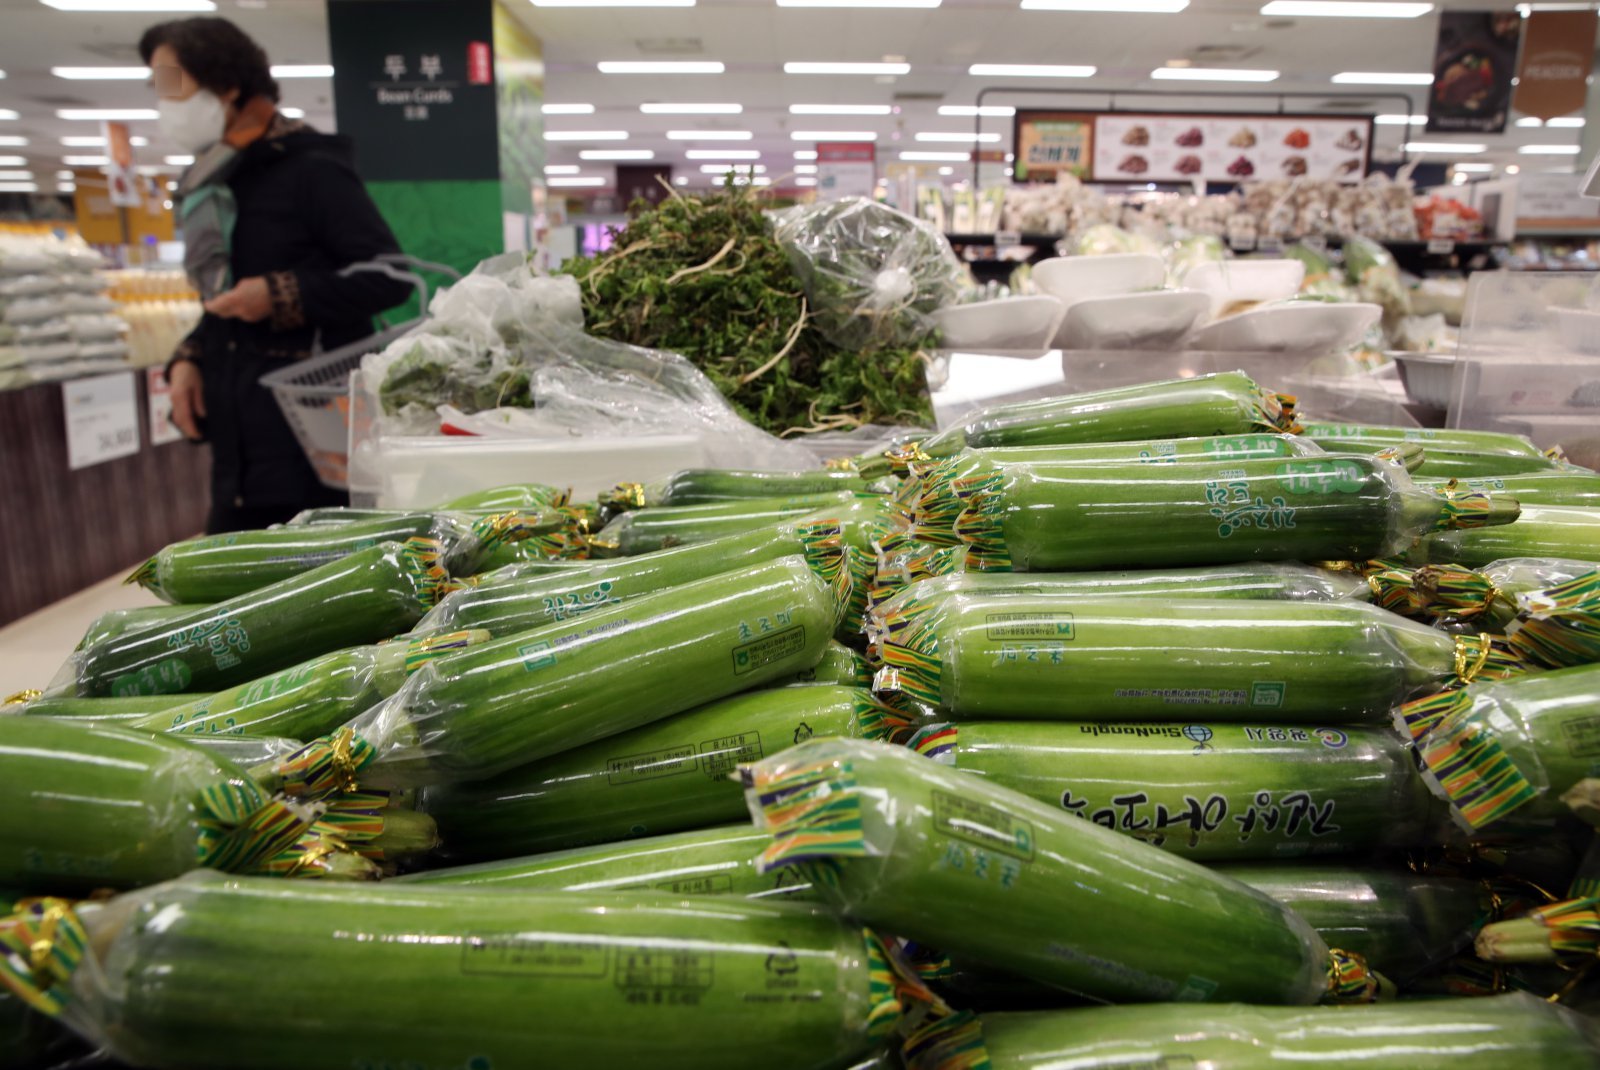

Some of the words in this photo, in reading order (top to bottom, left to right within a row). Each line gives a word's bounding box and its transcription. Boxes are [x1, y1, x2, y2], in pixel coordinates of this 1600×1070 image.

[1281, 463, 1359, 493] 애호박
[1230, 497, 1297, 529] 진주
[543, 592, 598, 621] 진주
[1244, 727, 1310, 742] 광양시
[1233, 789, 1341, 842] 진상
